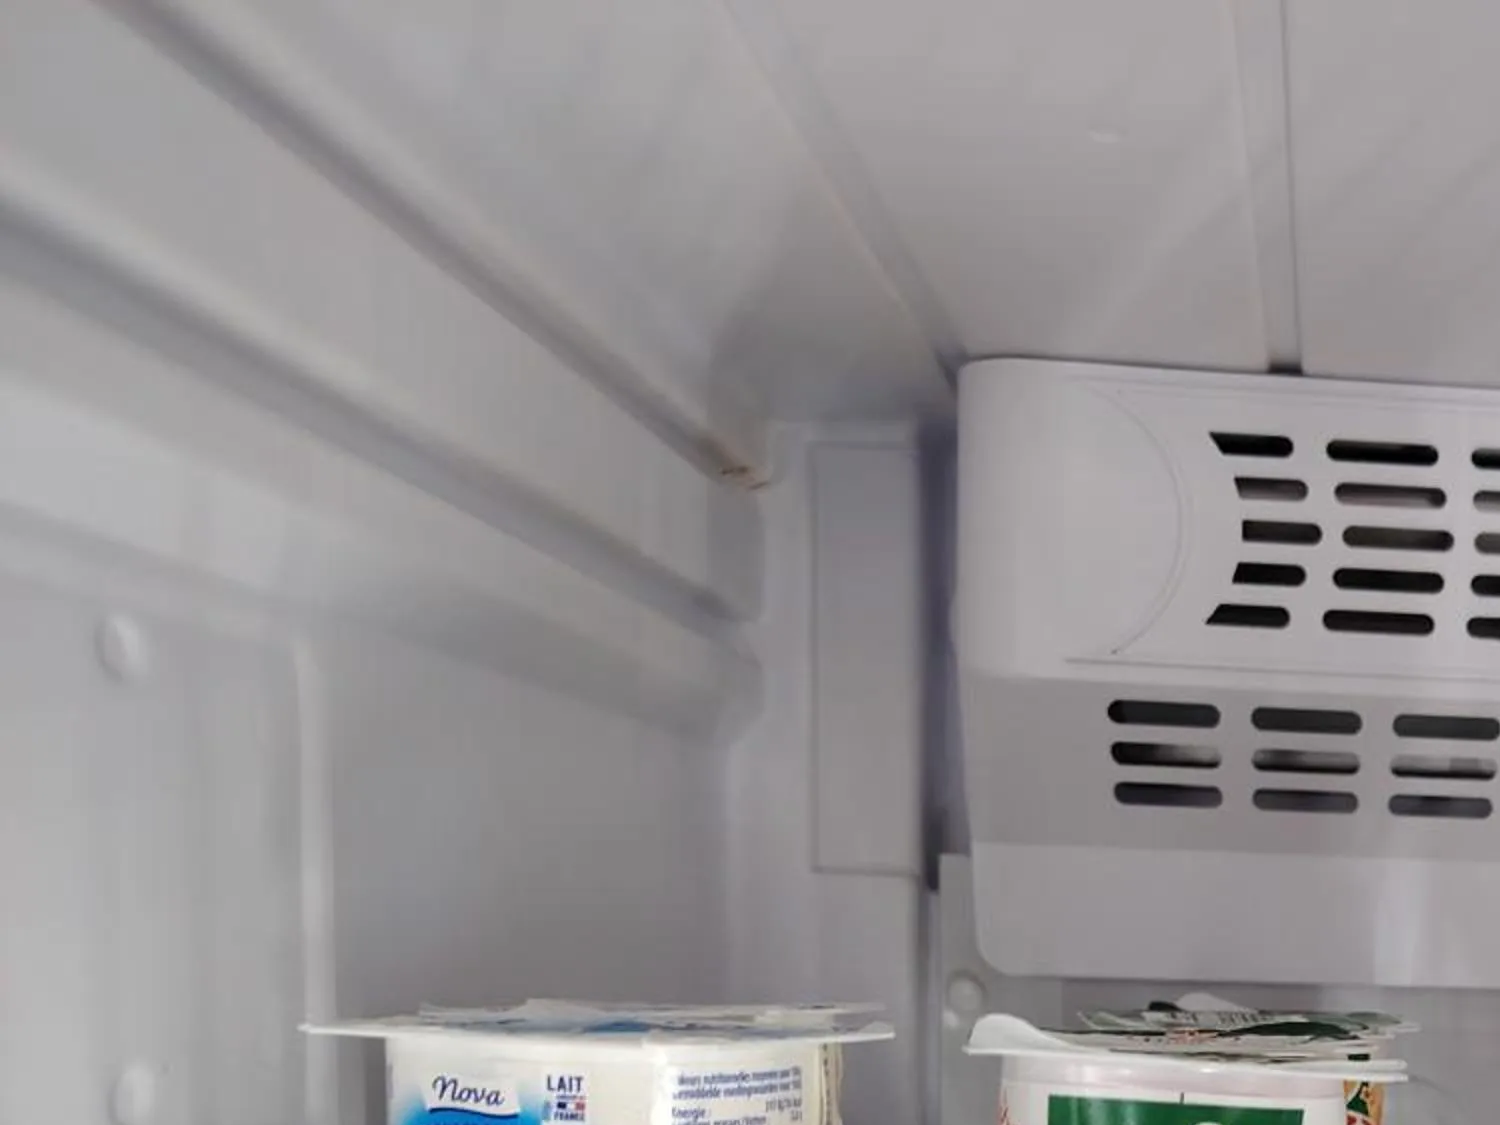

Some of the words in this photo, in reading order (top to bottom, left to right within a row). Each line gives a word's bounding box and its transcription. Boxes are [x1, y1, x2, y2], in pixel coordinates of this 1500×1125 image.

[432, 1076, 504, 1105] Nova
[547, 1075, 584, 1091] LAIT
[554, 1110, 585, 1121] FRANCE
